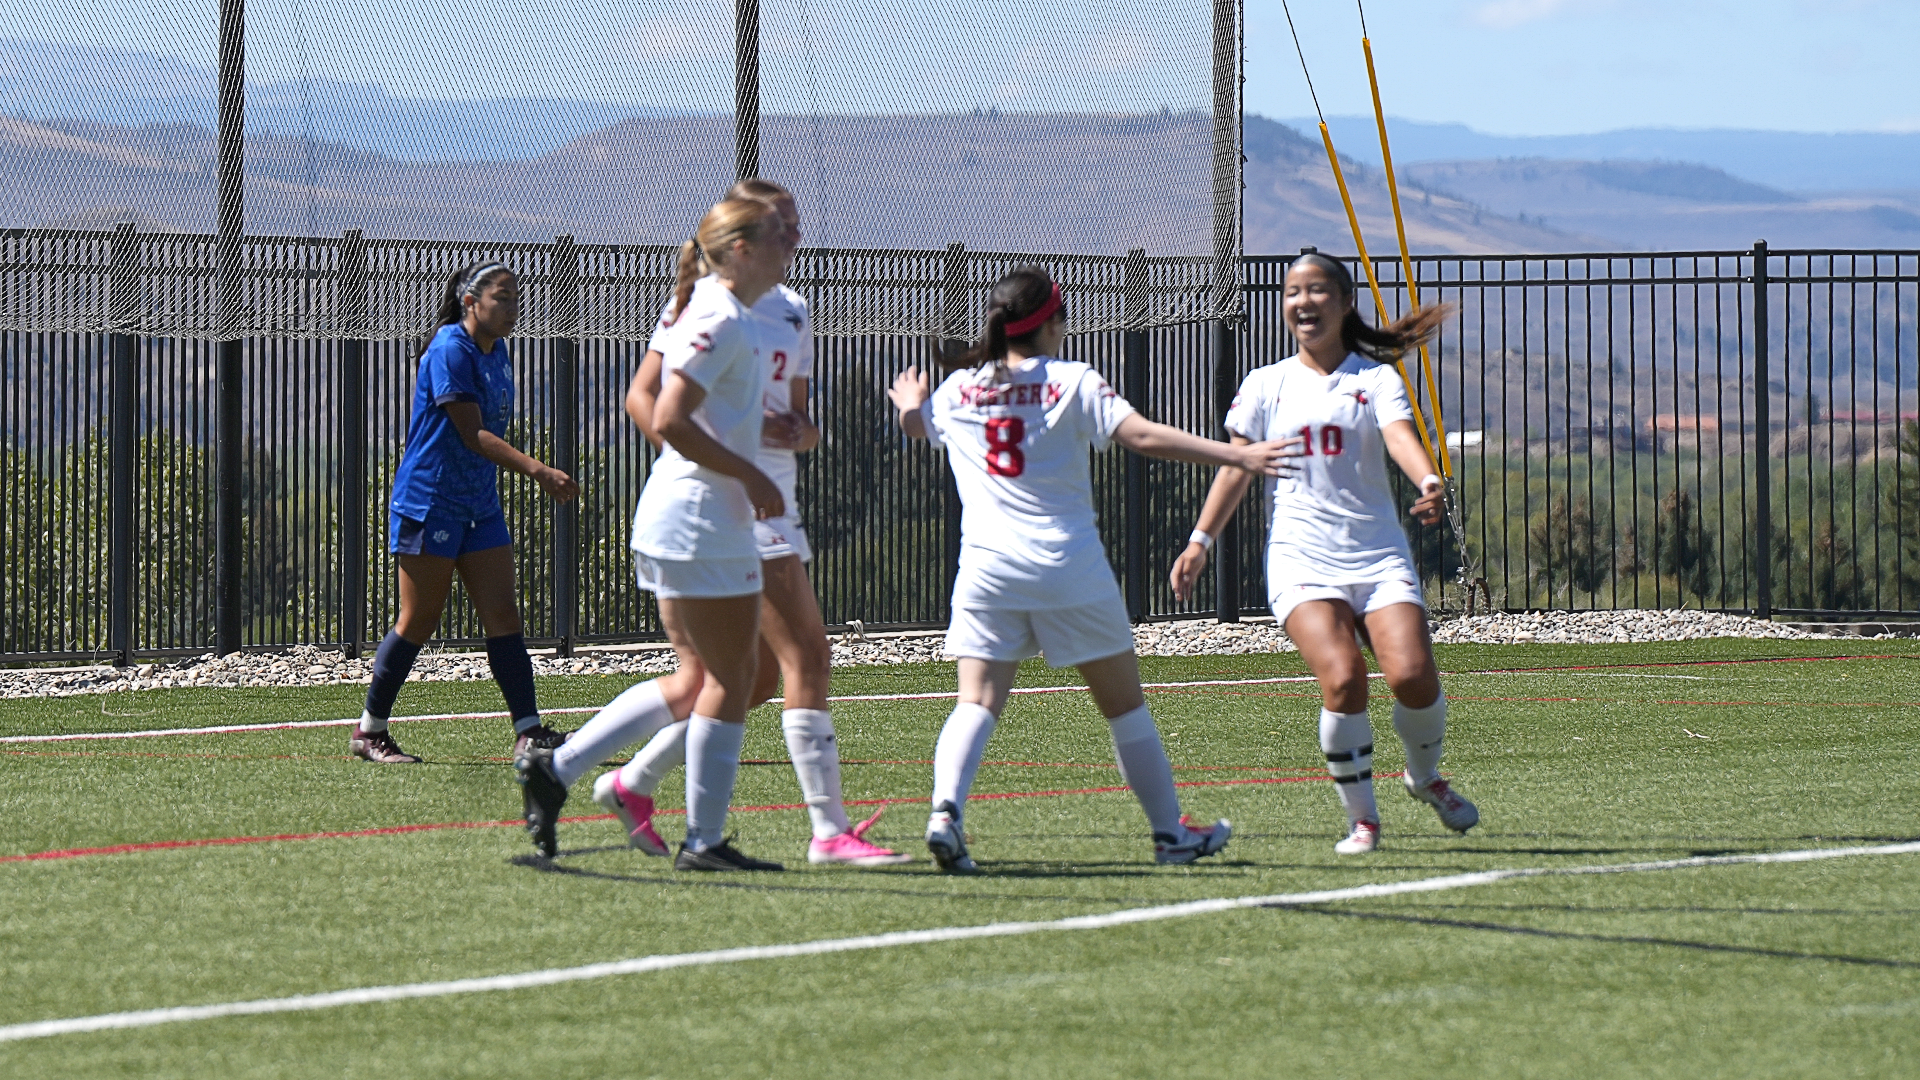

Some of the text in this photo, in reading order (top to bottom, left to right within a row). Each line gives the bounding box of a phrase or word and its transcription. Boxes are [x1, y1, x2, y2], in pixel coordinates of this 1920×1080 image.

[773, 351, 787, 381] 2
[985, 416, 1025, 478] 8
[1299, 425, 1342, 456] 10
